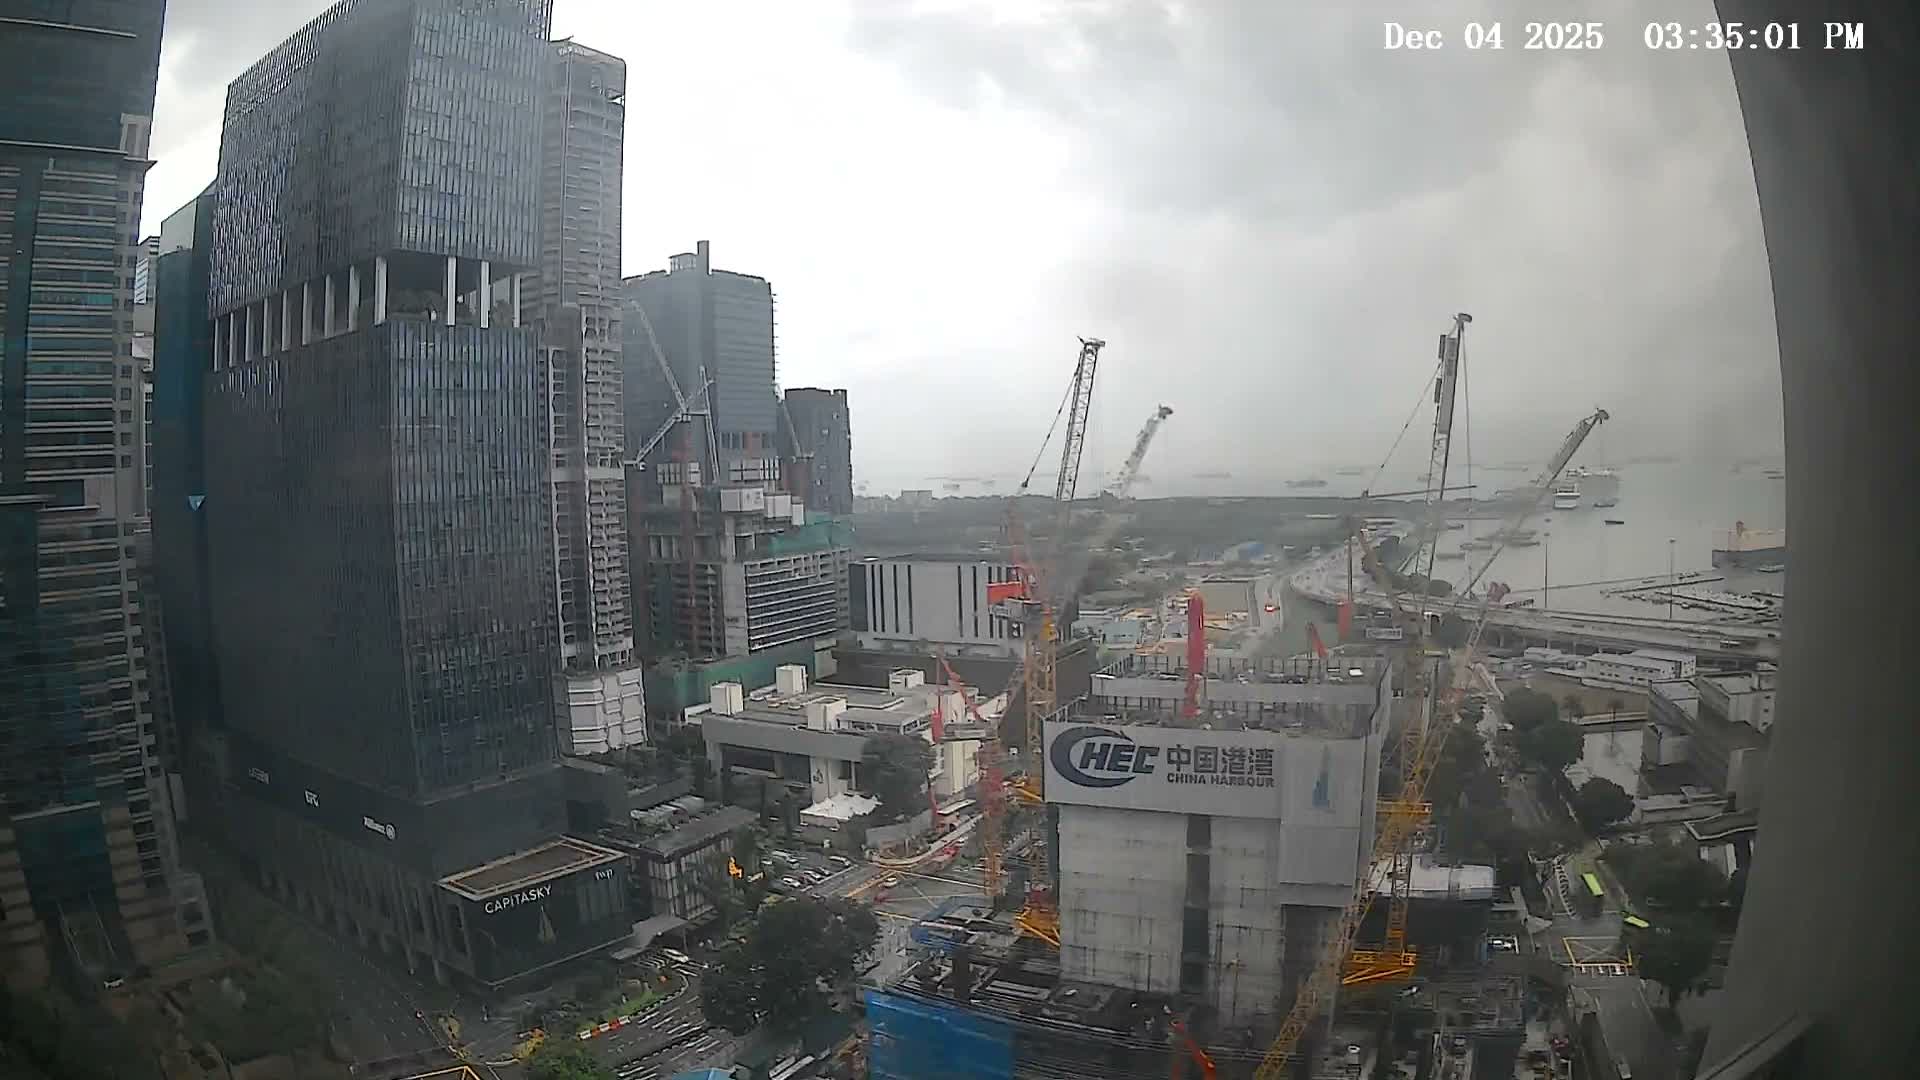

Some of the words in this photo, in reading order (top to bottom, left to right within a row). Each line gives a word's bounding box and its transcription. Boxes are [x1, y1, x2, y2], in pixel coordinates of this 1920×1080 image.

[1166, 743, 1275, 776] 中国港湾
[1167, 773, 1206, 785] CHINA
[1210, 774, 1275, 788] HARBOUR
[484, 884, 552, 914] CAPITASKY
